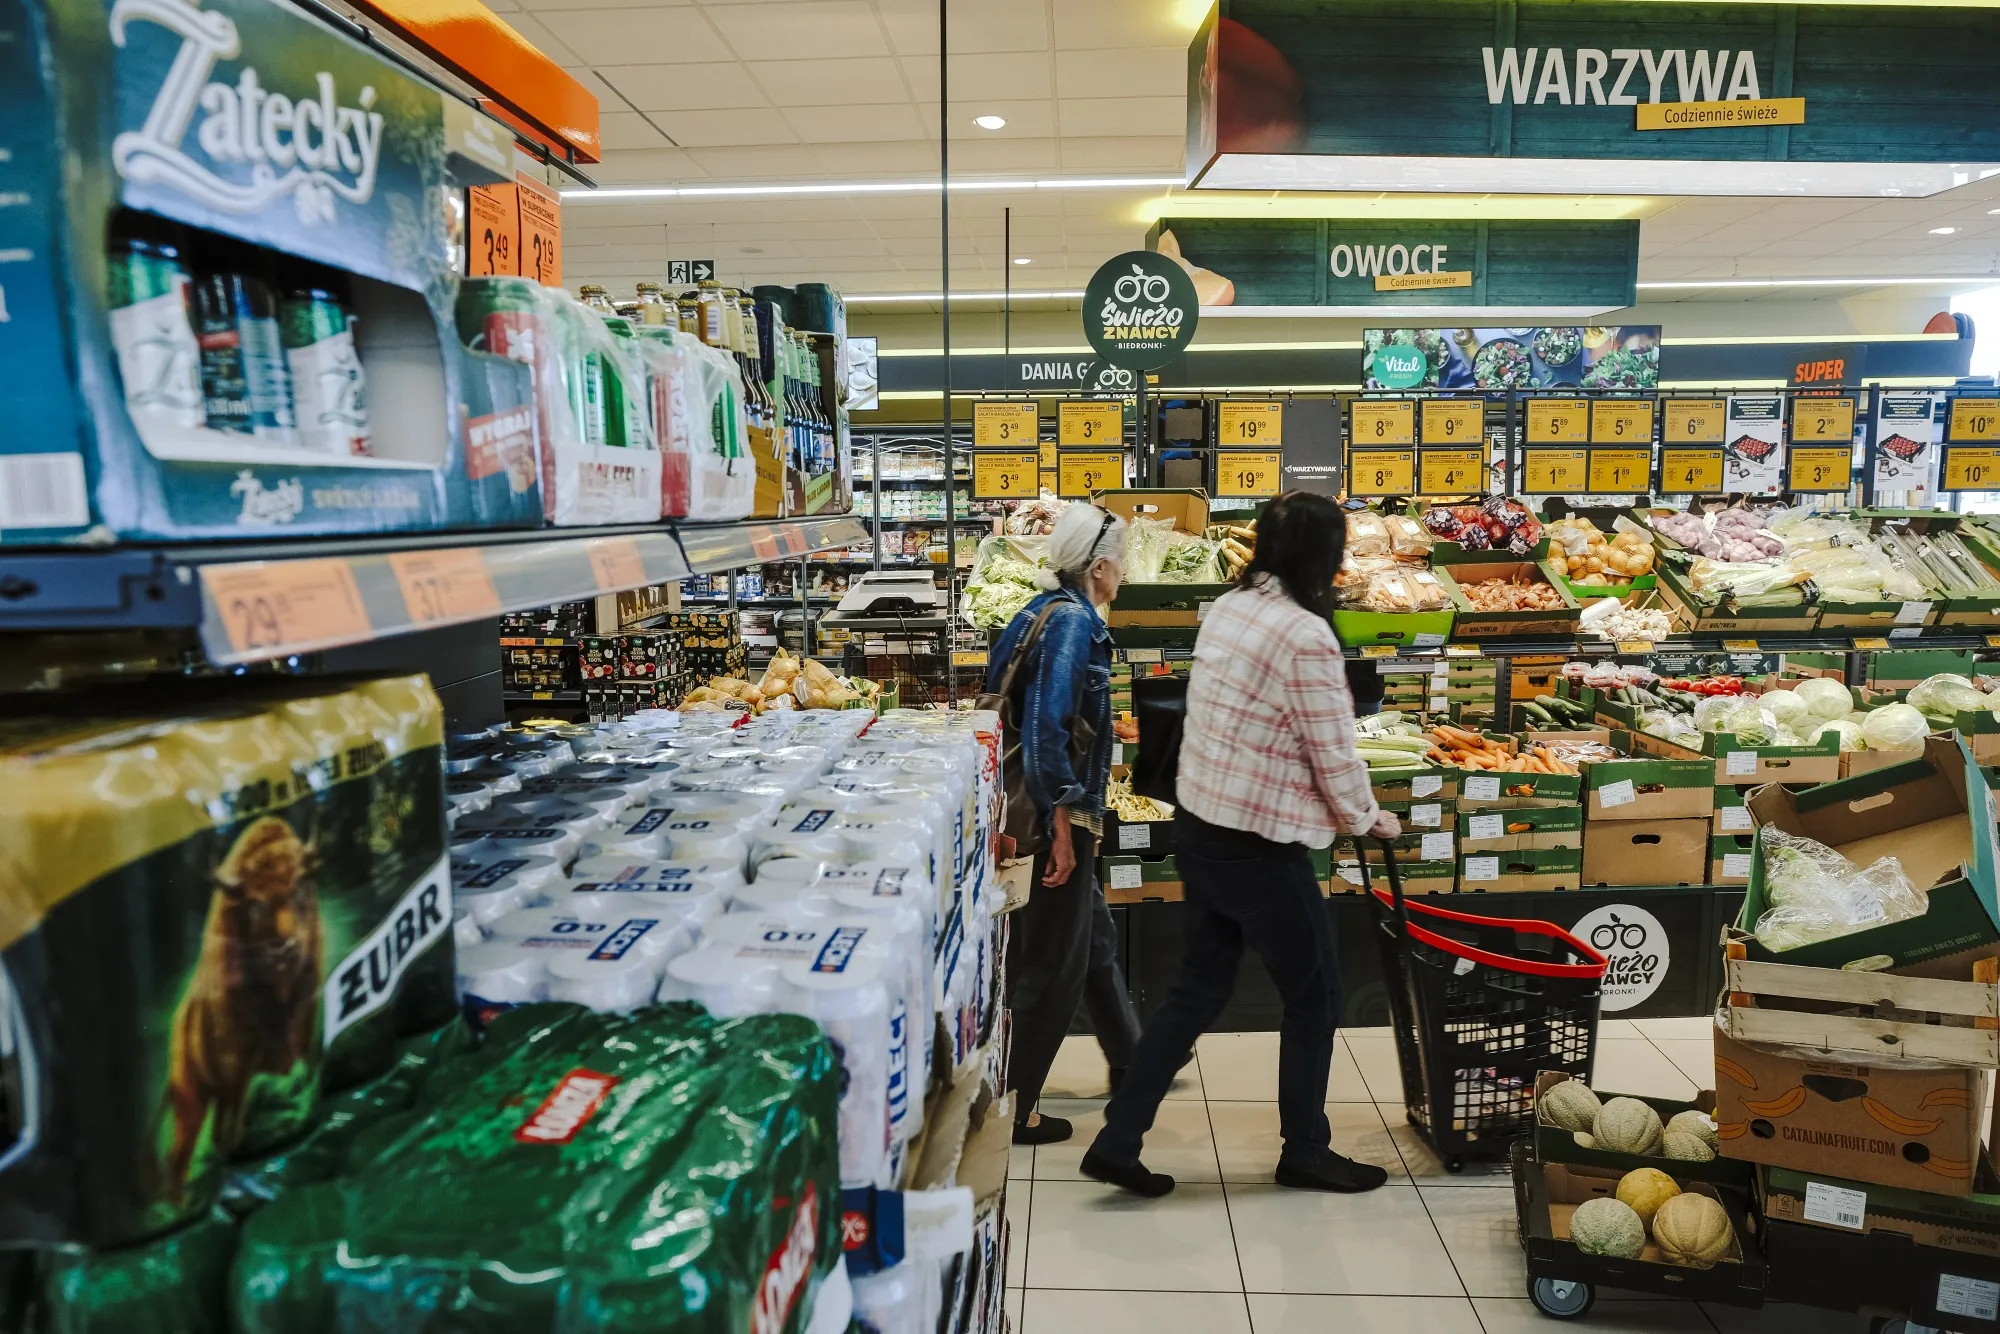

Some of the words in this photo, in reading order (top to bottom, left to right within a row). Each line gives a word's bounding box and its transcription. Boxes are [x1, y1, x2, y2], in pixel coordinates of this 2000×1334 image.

[1482, 47, 1761, 105] WARZYWA
[1664, 108, 1733, 123] Codziennie
[1737, 106, 1778, 120] świeże
[1330, 244, 1448, 277] OWOCE
[1390, 278, 1430, 288] Codziennie
[1433, 276, 1457, 286] świeże
[1101, 297, 1183, 326] Świeżo
[1103, 326, 1180, 340] ZNAWCY
[1022, 362, 1074, 380] DANIA
[1386, 355, 1421, 372] Vital
[1795, 359, 1844, 382] SUPER
[338, 884, 443, 1021] ZUBR
[1783, 1126, 1896, 1156] CATALINAFRUIT.COM
